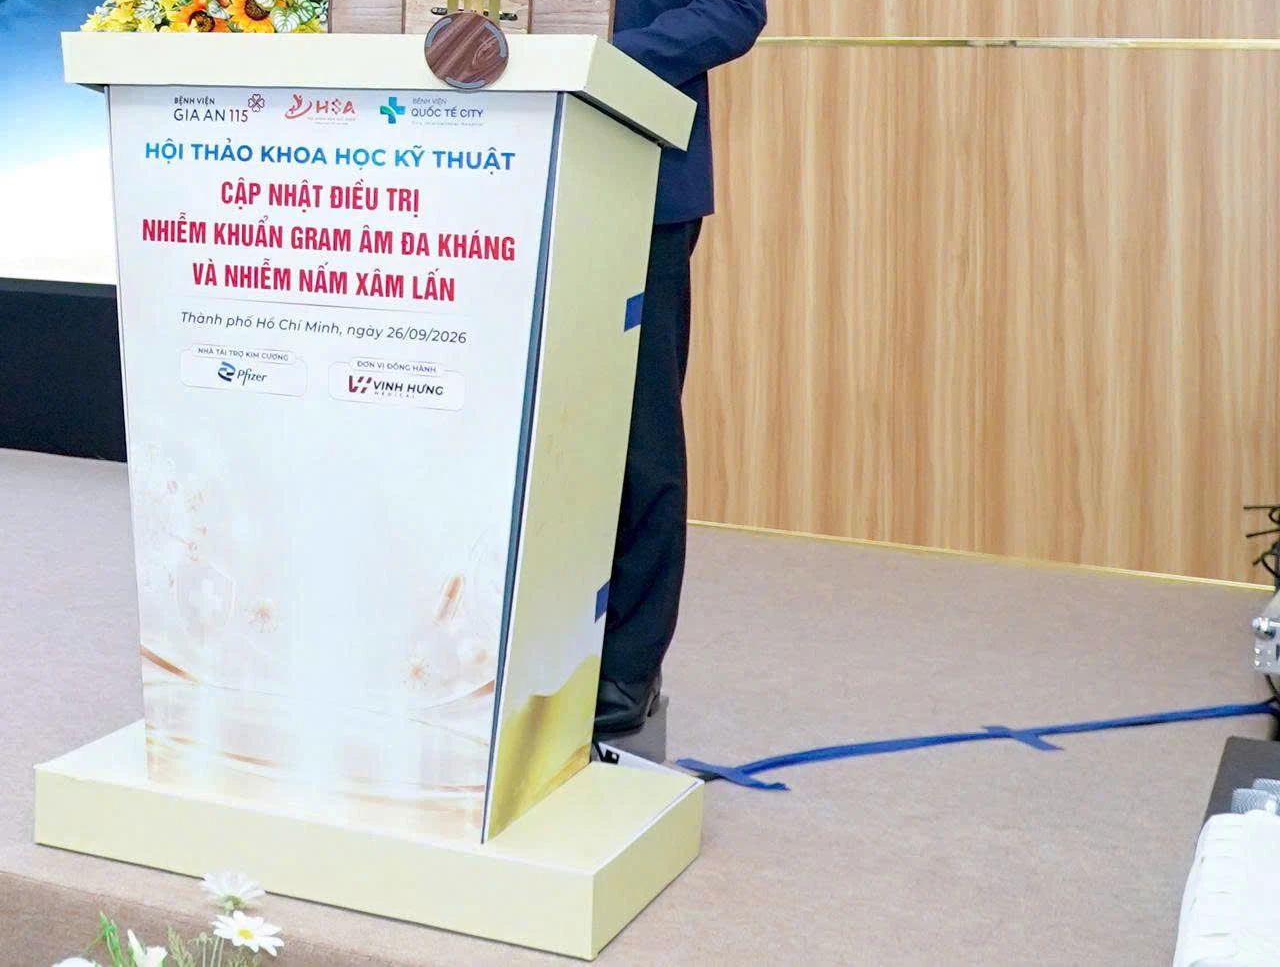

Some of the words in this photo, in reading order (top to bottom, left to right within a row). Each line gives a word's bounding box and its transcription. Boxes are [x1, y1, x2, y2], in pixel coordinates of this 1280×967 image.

[174, 95, 195, 107] BỆNH
[197, 96, 216, 107] VIỆN
[460, 108, 484, 118] CITY
[173, 108, 200, 122] GIA
[203, 108, 226, 122] AN
[229, 109, 249, 123] 115
[145, 138, 184, 164] HỘI
[191, 138, 253, 162] THẢO
[261, 145, 327, 165] KHOA
[335, 148, 386, 171] HỌC
[394, 145, 425, 168] KỸ
[432, 146, 516, 175] THUẬT
[221, 177, 262, 210] CẬP
[269, 179, 323, 213] NHẬT
[330, 178, 379, 211] ĐIỀU
[386, 187, 419, 218] TRỊ
[142, 212, 206, 244] NHIỄM
[214, 215, 283, 248] KHUẨN
[291, 226, 351, 252] GRAM
[359, 224, 393, 255] ÂM
[401, 232, 430, 256] ĐA
[438, 229, 515, 261] KHÁNG
[193, 259, 217, 286] VÀ
[224, 258, 291, 291] NHIỄM
[299, 262, 348, 295] NẤM
[355, 268, 404, 299] XÂM
[412, 268, 455, 302] LẤN
[181, 311, 222, 325] Thành
[225, 315, 252, 328] phố
[279, 318, 301, 331] Chí
[305, 320, 343, 335] Minh,
[346, 324, 383, 340] ngày
[387, 326, 467, 344] 26/09/2026
[236, 368, 267, 386] Pfizer
[373, 380, 403, 393] VINH
[407, 382, 444, 396] HƯNG
